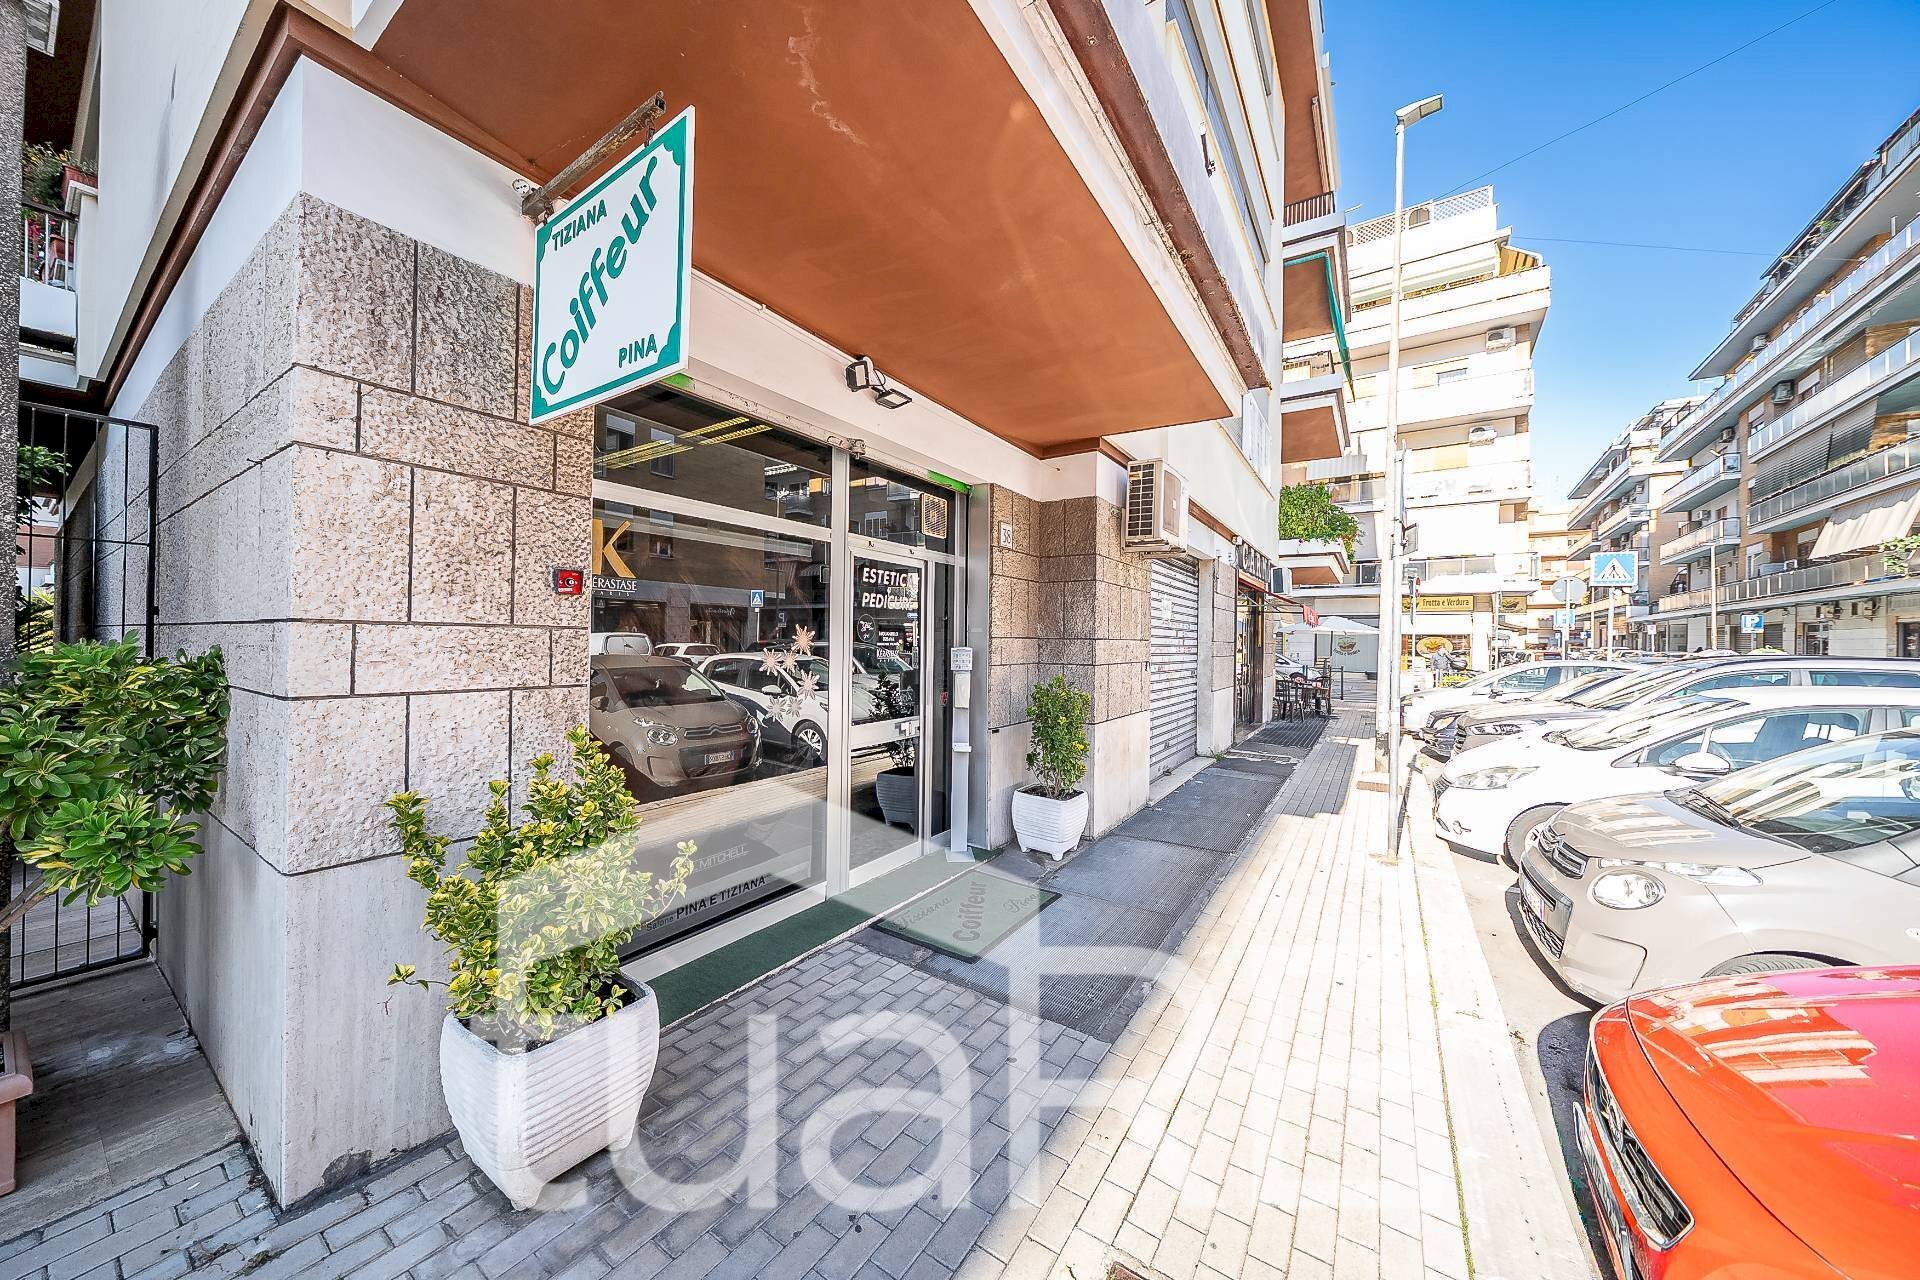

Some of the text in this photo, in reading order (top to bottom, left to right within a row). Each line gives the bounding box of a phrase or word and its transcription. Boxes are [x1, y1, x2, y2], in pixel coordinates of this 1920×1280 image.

[551, 199, 608, 252] TIZIANA
[541, 154, 659, 396] Coiffeur
[618, 332, 658, 369] PINA
[591, 518, 637, 579] K
[1002, 527, 1011, 544] 38
[592, 576, 638, 591] ÉRASTASE
[645, 875, 767, 932] Salone PINA E TIZIANA
[951, 880, 987, 943] Coiffeur
